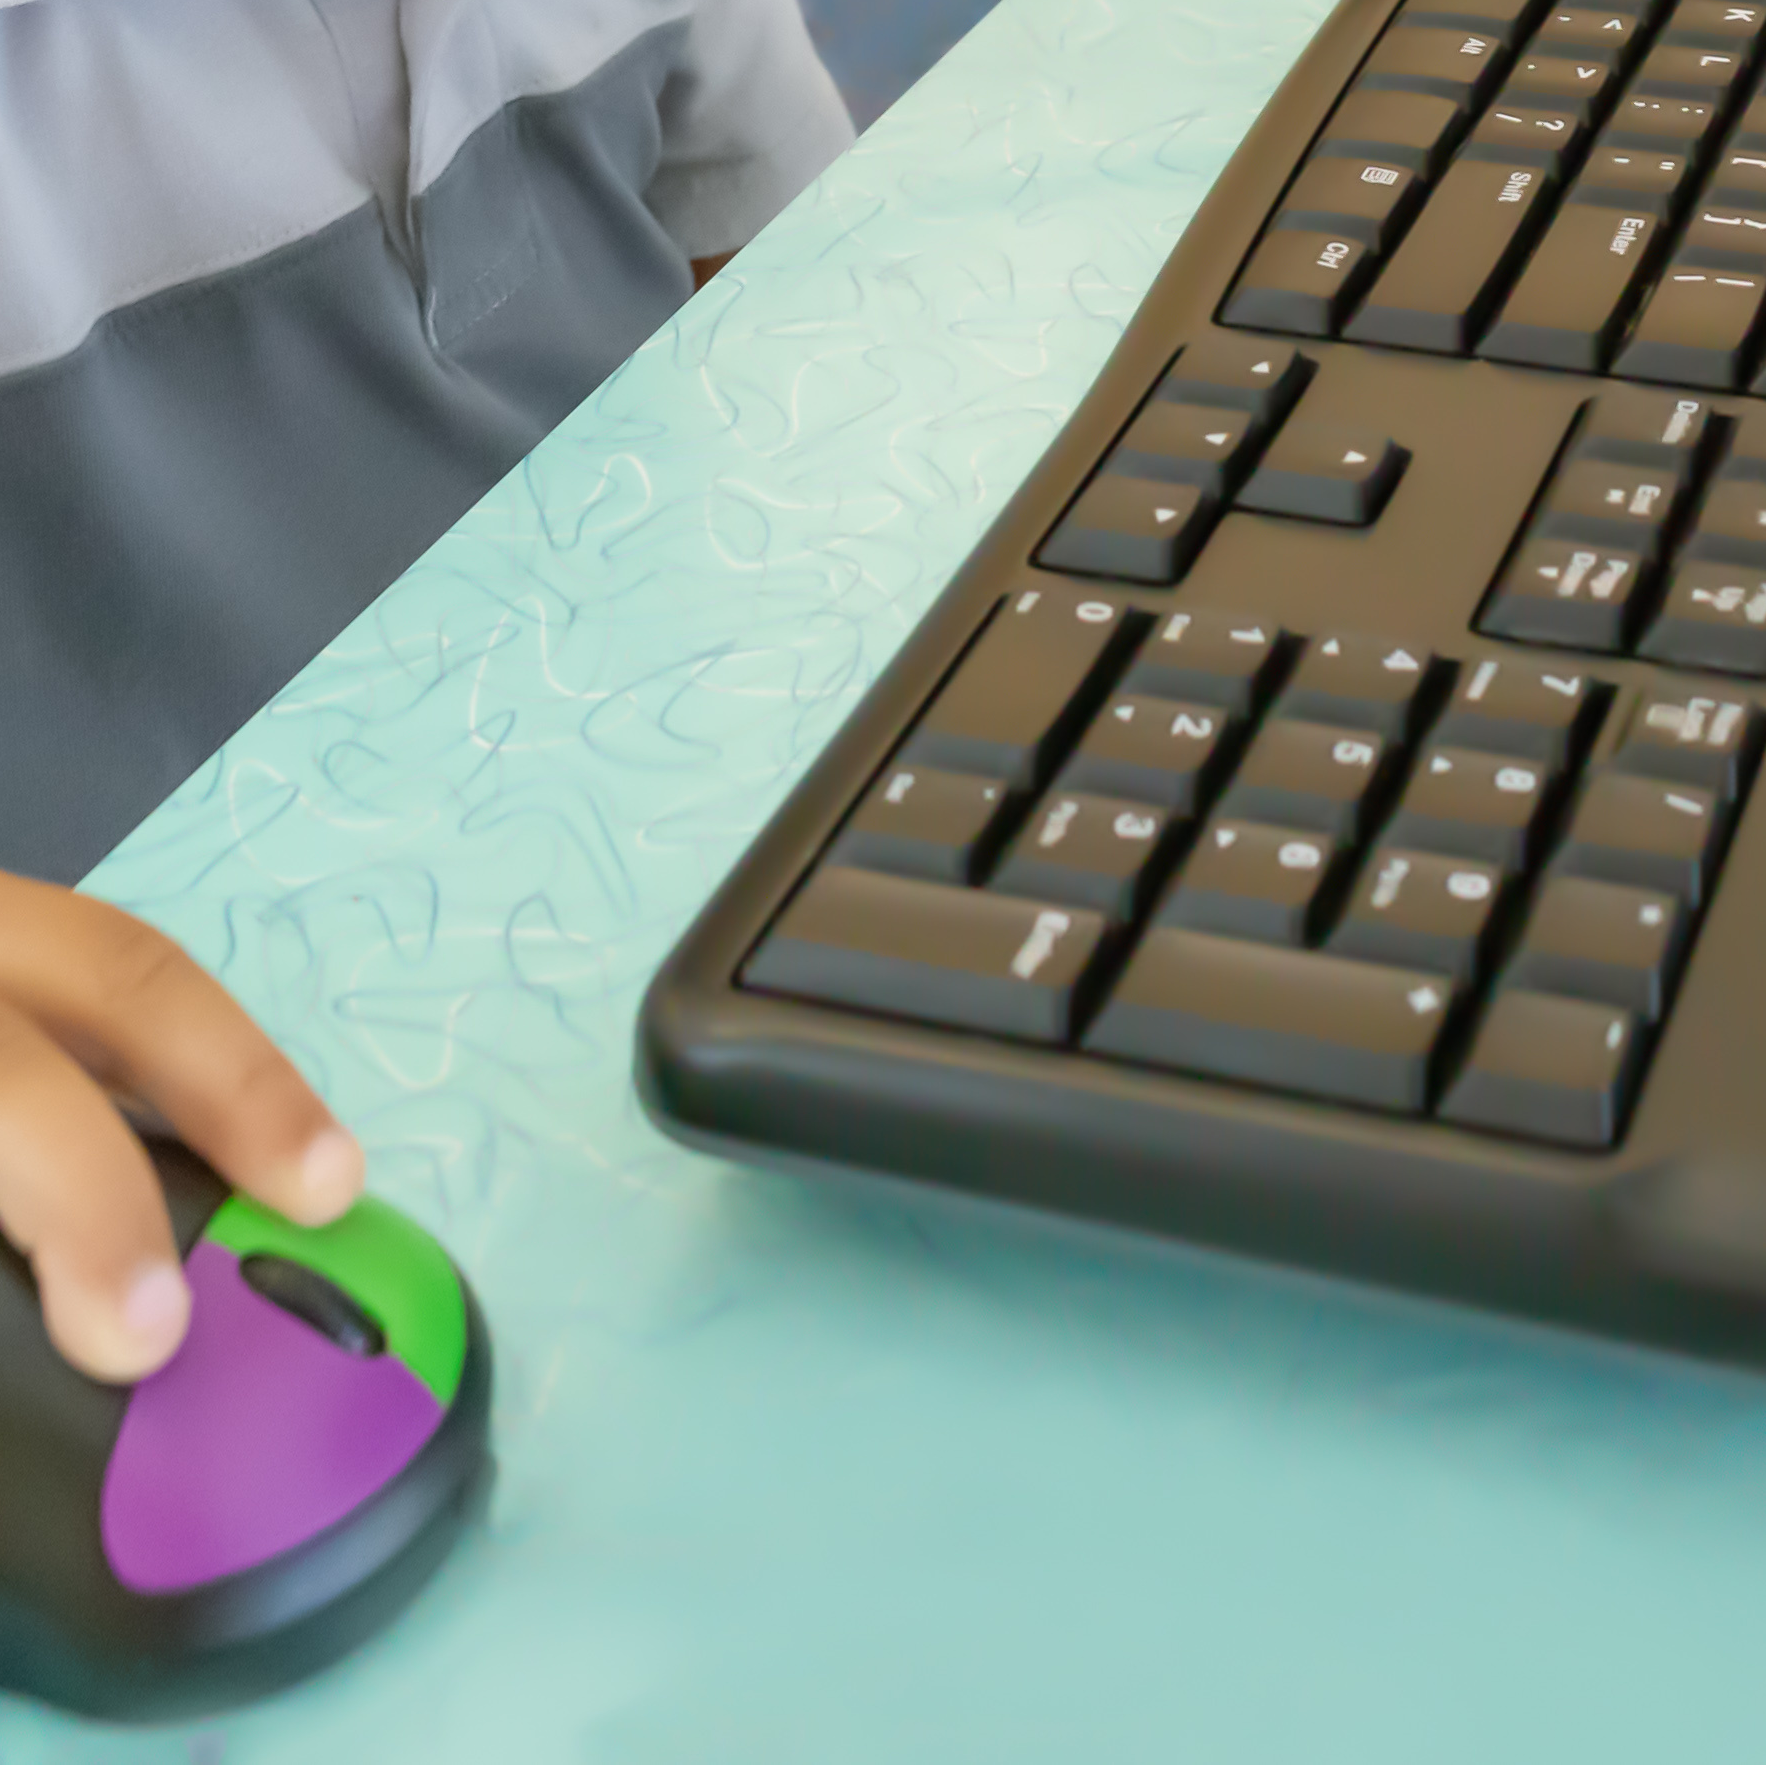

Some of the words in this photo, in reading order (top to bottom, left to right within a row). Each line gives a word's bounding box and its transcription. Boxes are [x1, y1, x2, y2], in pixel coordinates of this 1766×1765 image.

[1722, 7, 1756, 23] K
[1459, 36, 1487, 55] Alt
[1699, 54, 1732, 67] L
[1534, 119, 1566, 132] ?
[1497, 171, 1533, 203] Shift
[1609, 217, 1646, 256] Enter
[1316, 241, 1350, 269] Ctrl
[1075, 600, 1114, 623] 0
[1229, 625, 1266, 644] 1
[1540, 674, 1581, 697] 7
[1170, 712, 1213, 739] 2
[1332, 738, 1375, 766] 5
[1113, 810, 1156, 839] 3
